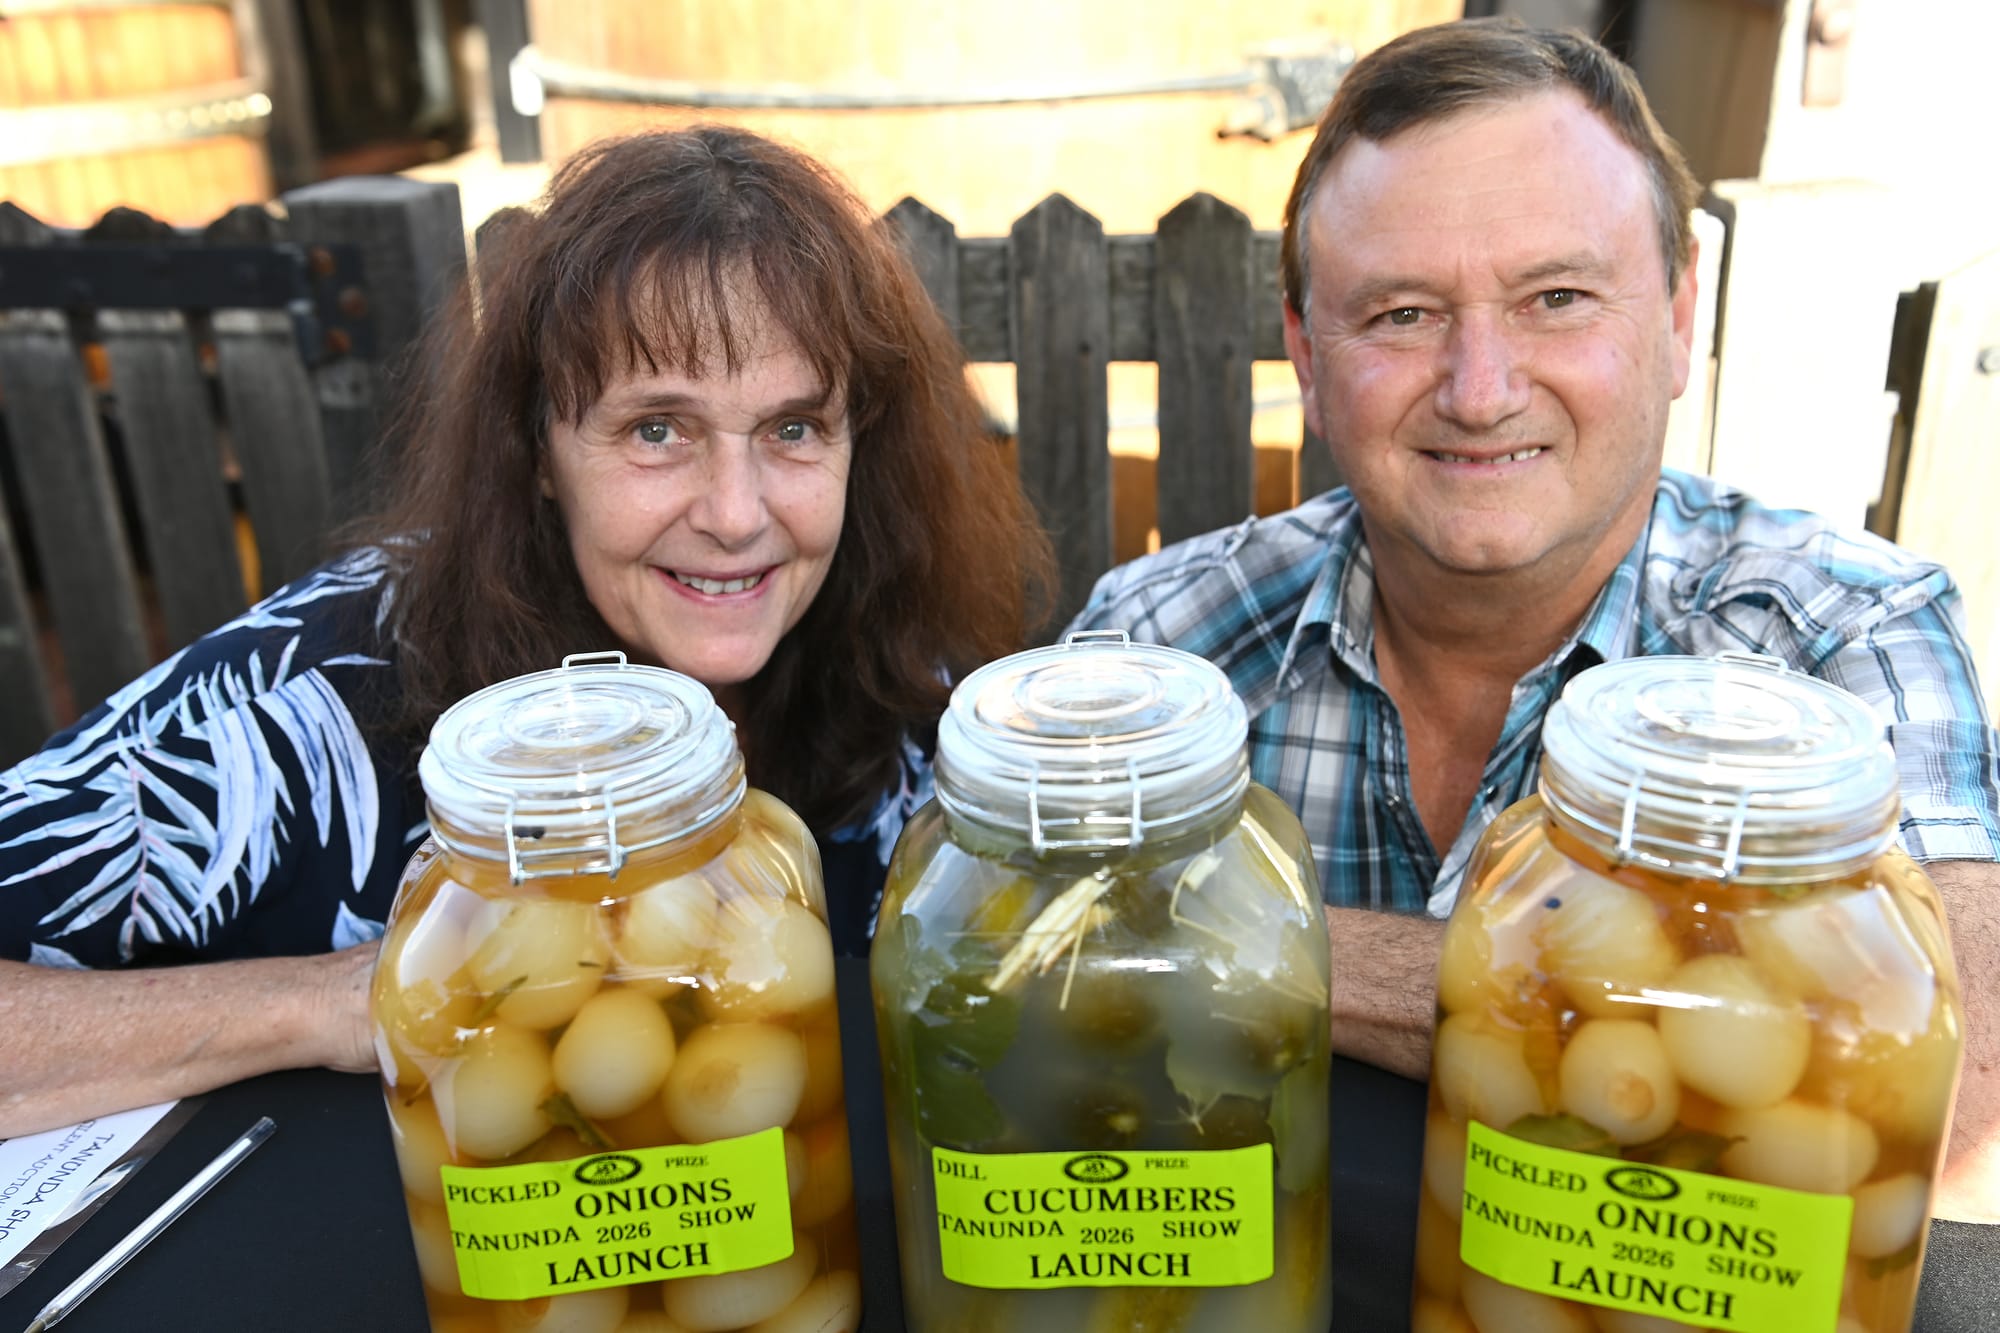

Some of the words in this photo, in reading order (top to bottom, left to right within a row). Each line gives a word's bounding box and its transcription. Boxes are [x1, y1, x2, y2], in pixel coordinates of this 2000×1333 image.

[22, 1134, 115, 1206] TANUNDA
[664, 1156, 709, 1169] PRIZE
[937, 1158, 987, 1180] DILL
[1144, 1157, 1190, 1169] PRIZE
[1470, 1142, 1588, 1194] PICKLED
[447, 1180, 561, 1205] PICKLED
[575, 1178, 733, 1219] ONIONS
[984, 1186, 1236, 1215] CUCUMBERS
[451, 1226, 581, 1251] TANUNDA
[596, 1222, 651, 1244] 2026
[679, 1203, 757, 1230] SHOW
[938, 1212, 1065, 1238] TANUNDA
[1080, 1228, 1135, 1245] 2026
[1162, 1219, 1242, 1239] SHOW
[1463, 1190, 1596, 1249] TANUNDA
[1612, 1242, 1674, 1270] 2026
[1706, 1254, 1804, 1289] SHOW
[1597, 1201, 1778, 1258] ONIONS
[546, 1242, 711, 1287] LAUNCH
[1029, 1252, 1191, 1279] LAUNCH
[1549, 1260, 1737, 1321] LAUNCH
